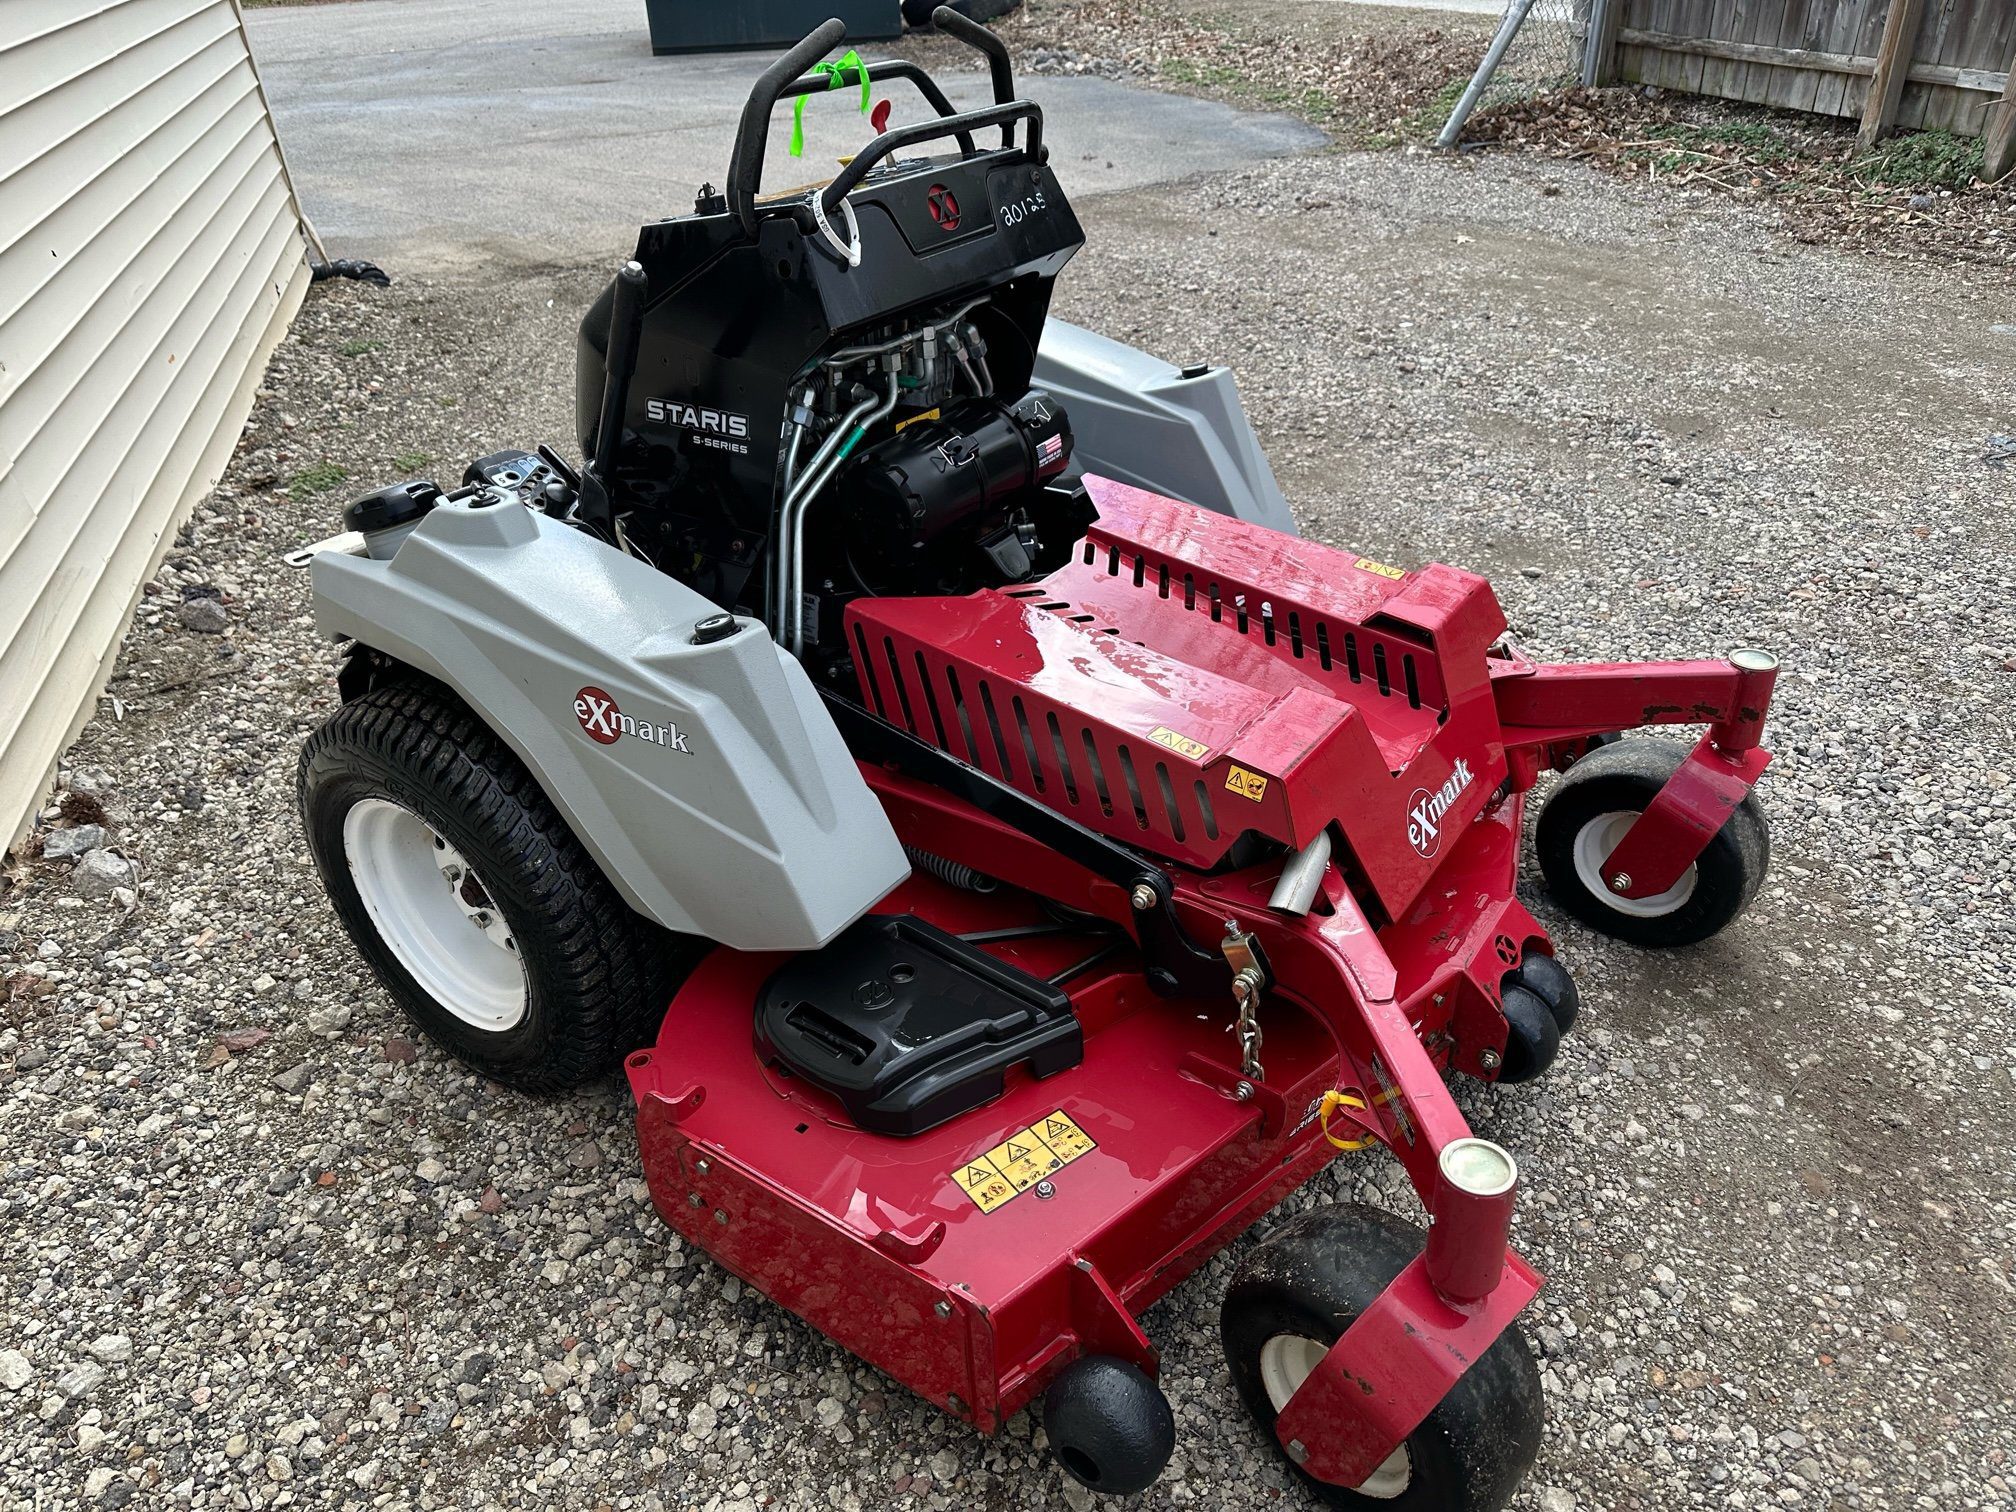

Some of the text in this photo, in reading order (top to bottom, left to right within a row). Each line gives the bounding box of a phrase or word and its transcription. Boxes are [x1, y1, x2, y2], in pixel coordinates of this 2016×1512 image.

[646, 398, 749, 438] STARIS
[572, 693, 690, 754] eXmark
[1407, 757, 1474, 852] eXmark
